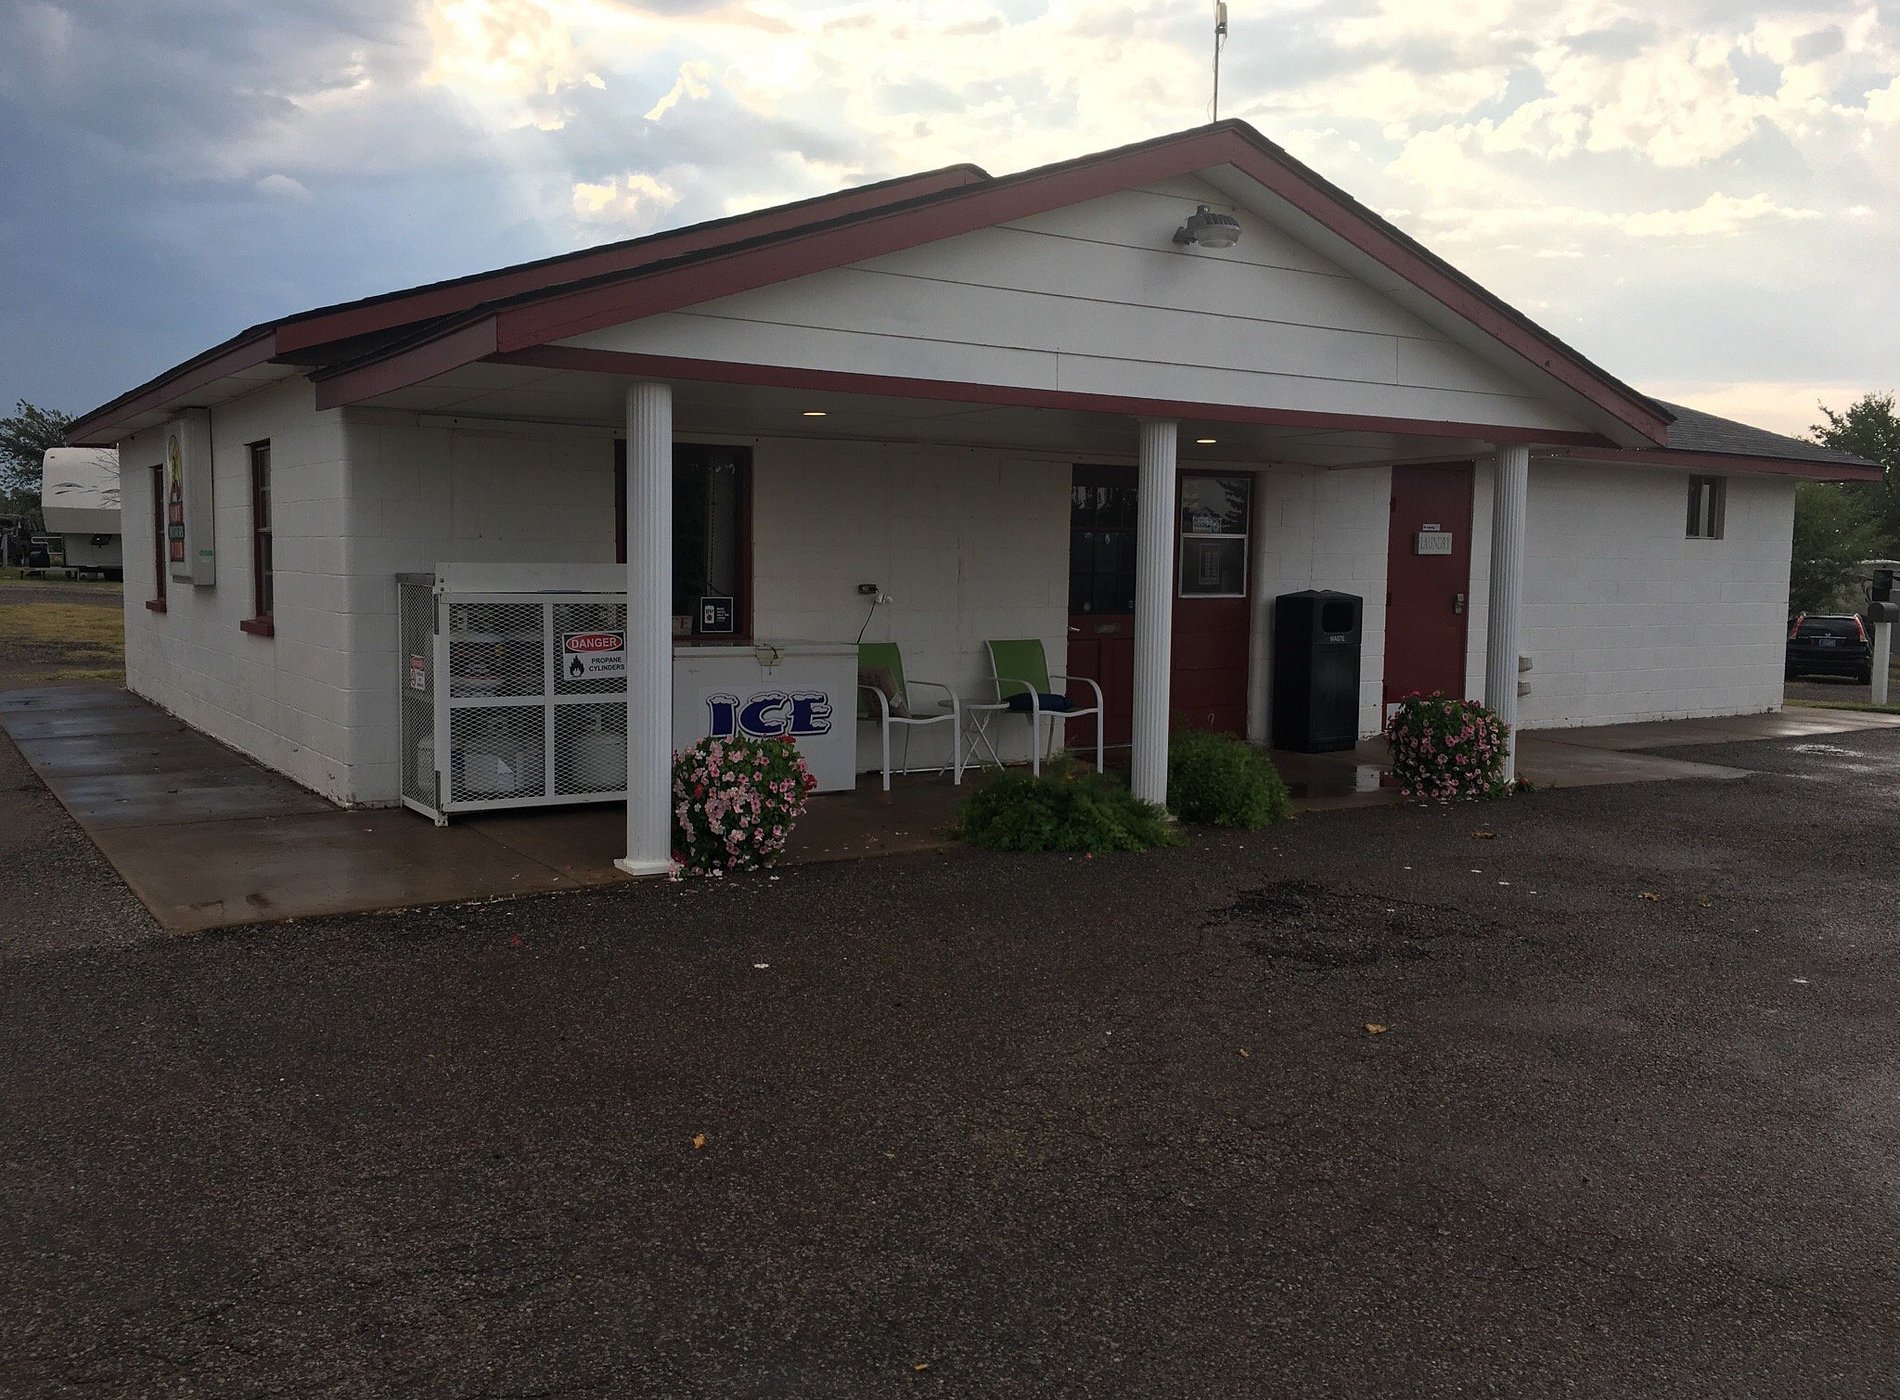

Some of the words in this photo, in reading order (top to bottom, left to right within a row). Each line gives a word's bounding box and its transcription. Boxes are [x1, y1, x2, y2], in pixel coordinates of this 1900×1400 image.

[1420, 537, 1450, 549] LAUNDRY
[571, 638, 617, 649] DANGER
[588, 664, 625, 672] CYLINDERS
[707, 690, 832, 738] ICE
